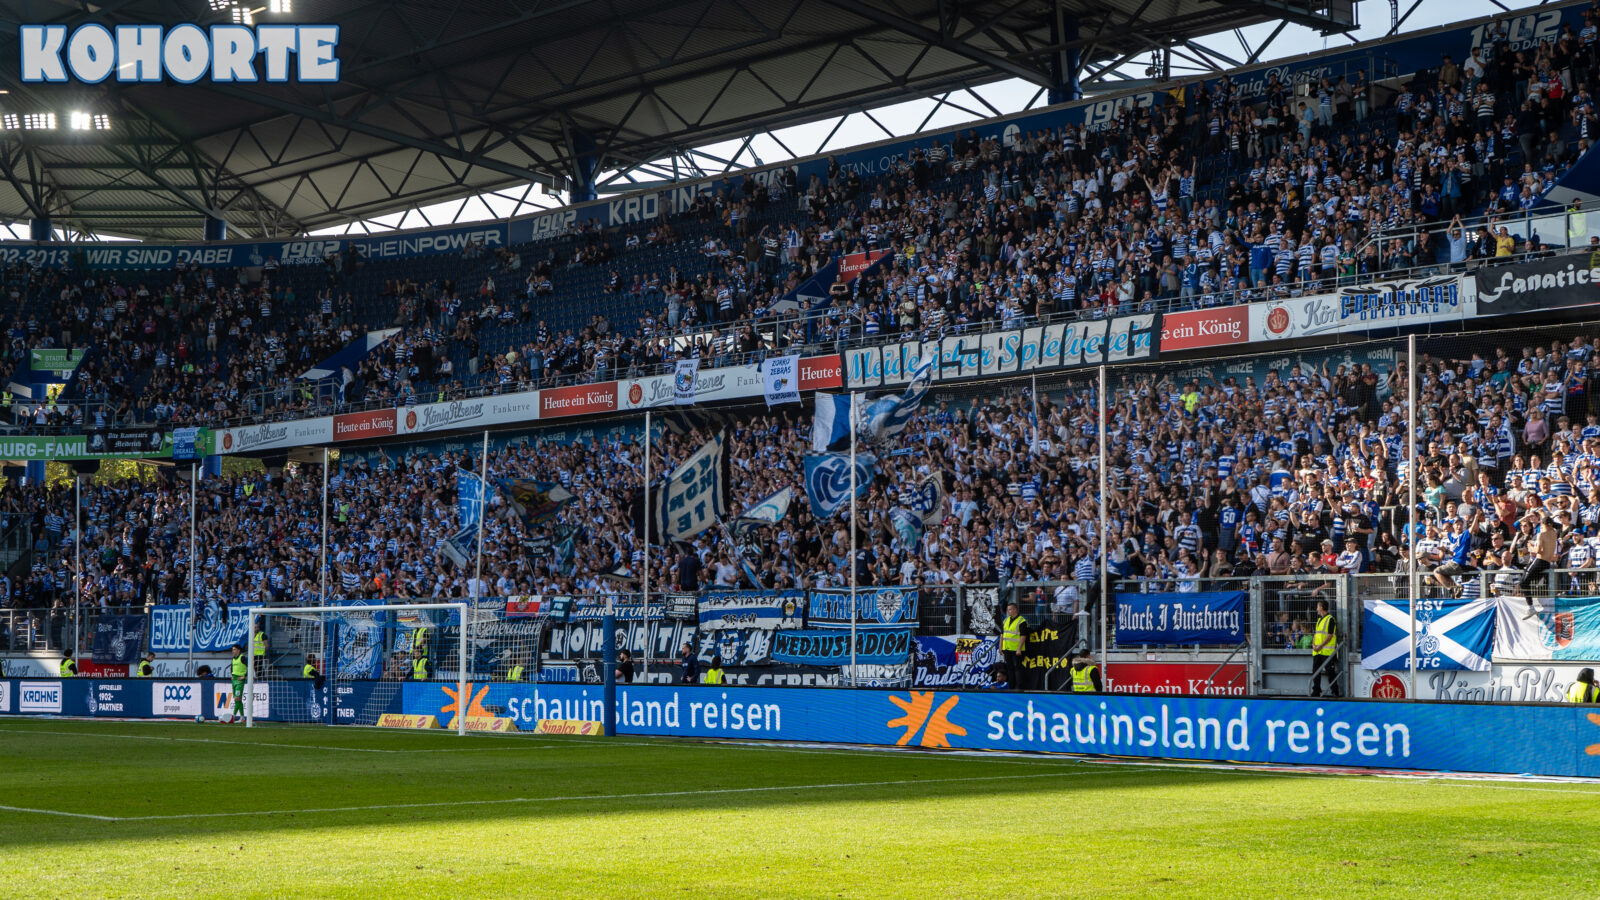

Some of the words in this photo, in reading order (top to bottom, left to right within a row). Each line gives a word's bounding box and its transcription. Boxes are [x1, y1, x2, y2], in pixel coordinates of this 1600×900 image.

[86, 249, 122, 264] WIR
[125, 249, 172, 264] SIND
[181, 248, 233, 264] DABEI
[1172, 324, 1196, 339] ein
[1198, 318, 1242, 339] König
[801, 365, 829, 381] Heute
[544, 395, 570, 410] Heute
[571, 394, 585, 407] ein
[587, 392, 614, 408] König
[422, 408, 450, 428] König
[448, 401, 484, 419] Pilsener
[493, 402, 530, 415] Fankurve
[336, 420, 359, 434] Heute
[359, 419, 370, 432] ein
[370, 416, 394, 431] König
[236, 429, 261, 447] König
[257, 424, 288, 443] Pilsener
[294, 426, 326, 438] Fankurve
[1223, 512, 1236, 523] 50
[1118, 603, 1155, 632] Block
[1172, 603, 1240, 636] Duisburg
[23, 690, 58, 703] KROHNE
[98, 692, 114, 701] 1902-
[164, 685, 192, 703] pape
[98, 703, 123, 712] PARTNER
[163, 705, 181, 713] gruppe
[689, 692, 781, 732] reisen
[380, 713, 413, 729] Sinalco
[542, 720, 576, 735] Sinalco
[987, 700, 1250, 751] schauinsland
[1266, 707, 1411, 758] reisen
